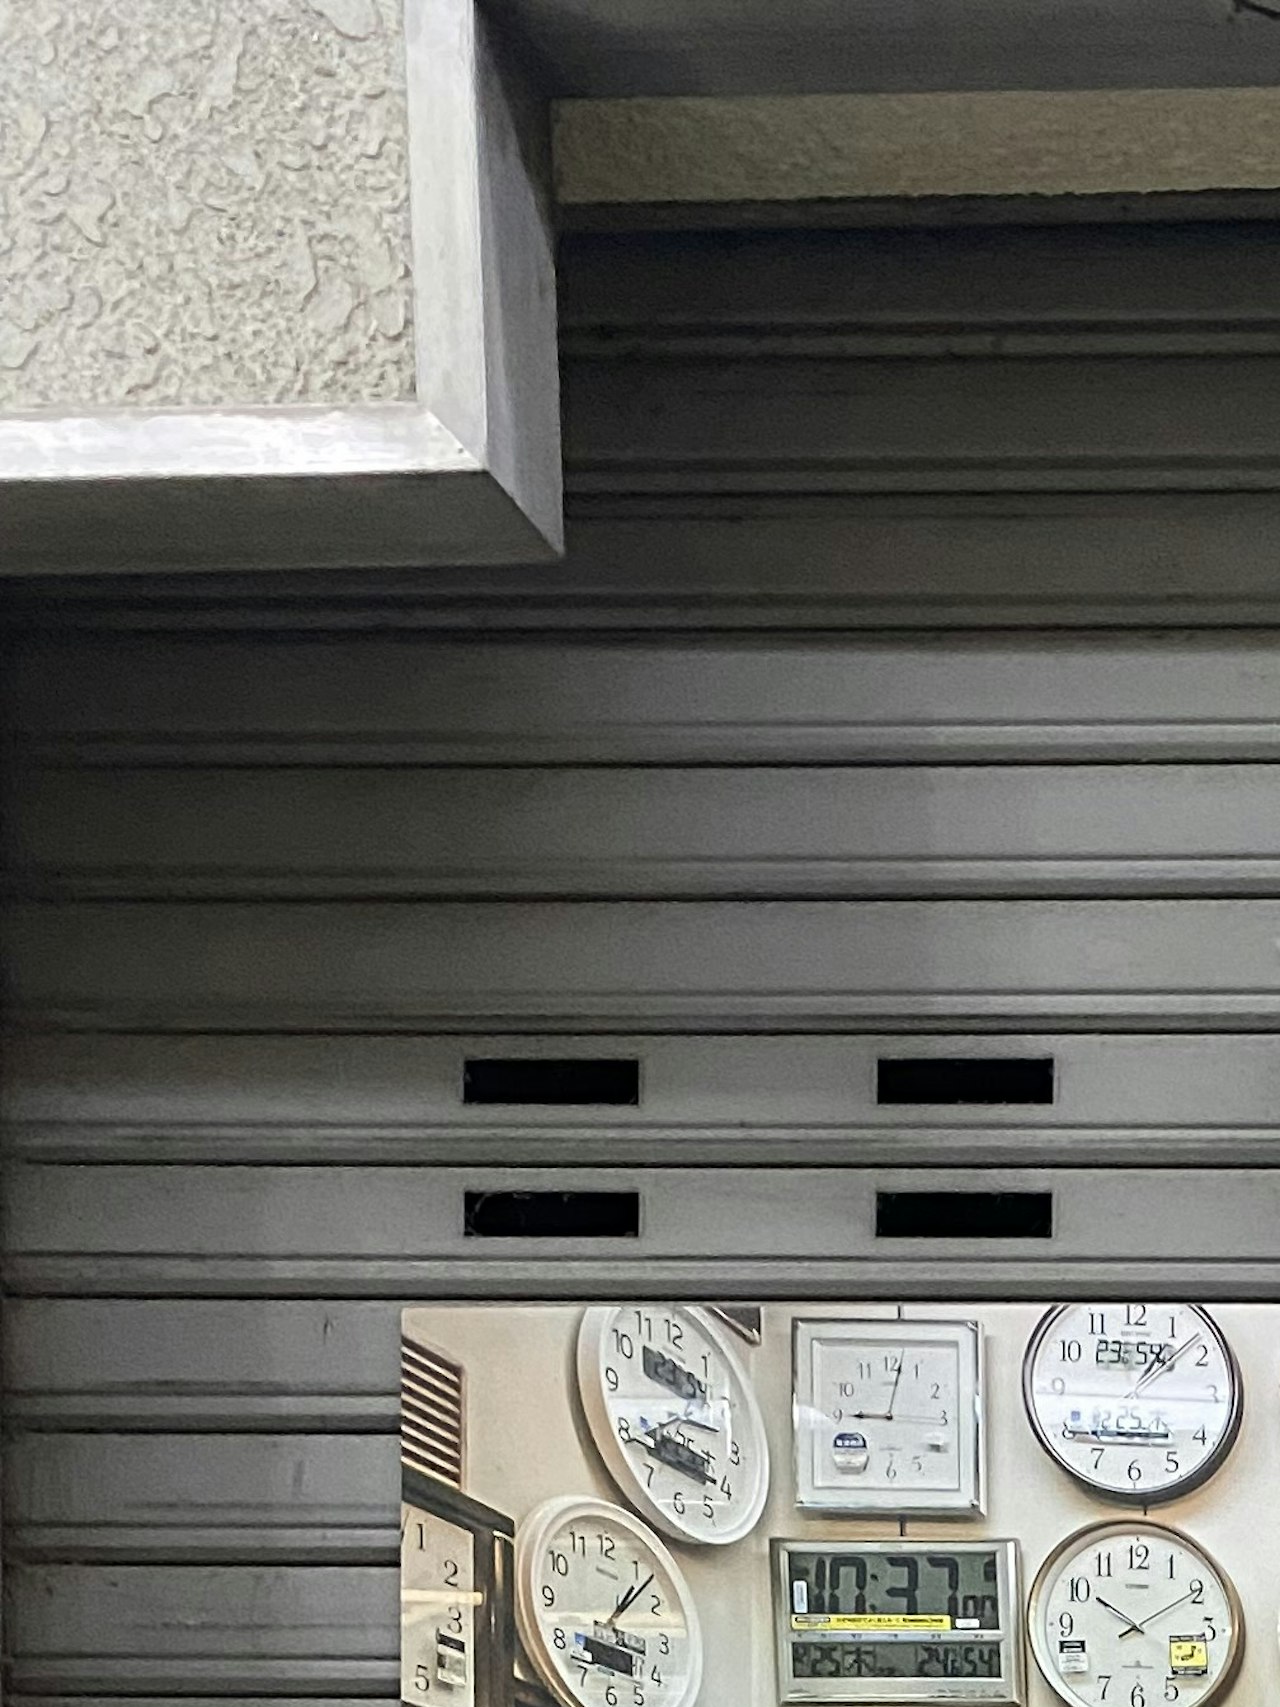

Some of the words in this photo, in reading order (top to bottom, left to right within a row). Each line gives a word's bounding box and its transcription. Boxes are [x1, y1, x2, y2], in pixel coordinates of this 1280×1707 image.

[1090, 1313, 1105, 1335] 11
[1124, 1305, 1147, 1325] 12
[1170, 1317, 1175, 1338] 1
[1061, 1340, 1081, 1361] 10
[1195, 1345, 1208, 1366] 2
[1091, 1448, 1104, 1469] 7
[1165, 1452, 1178, 1473] 5
[1128, 1461, 1141, 1480] 6
[1097, 1553, 1112, 1577] 11
[1129, 1545, 1149, 1570] 12
[1170, 1555, 1173, 1578] 1
[1070, 1578, 1090, 1602] 10
[1187, 1579, 1203, 1604] 2
[1059, 1613, 1073, 1637] 9
[1204, 1617, 1216, 1640] 3
[1098, 1676, 1111, 1700] 7
